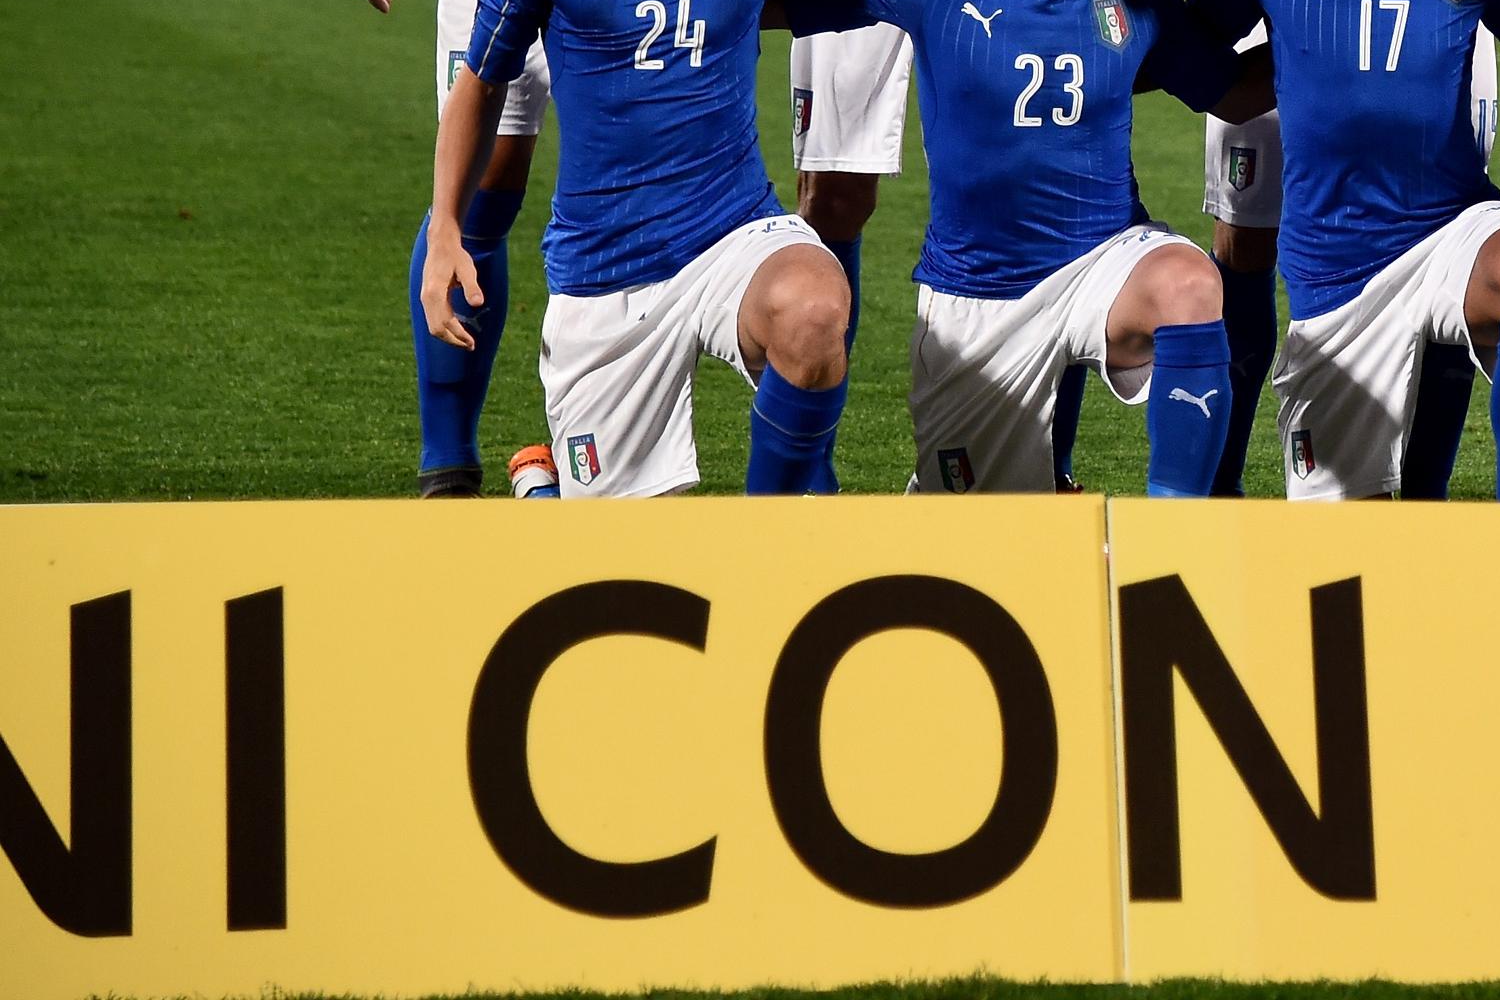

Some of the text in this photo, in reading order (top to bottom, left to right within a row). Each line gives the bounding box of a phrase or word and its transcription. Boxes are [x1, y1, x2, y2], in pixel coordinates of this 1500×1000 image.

[1096, 0, 1118, 8] ITALIA
[1360, 0, 1410, 71] 17
[1014, 54, 1083, 126] 23
[568, 436, 590, 446] ITALIA
[468, 574, 1377, 920] CON
